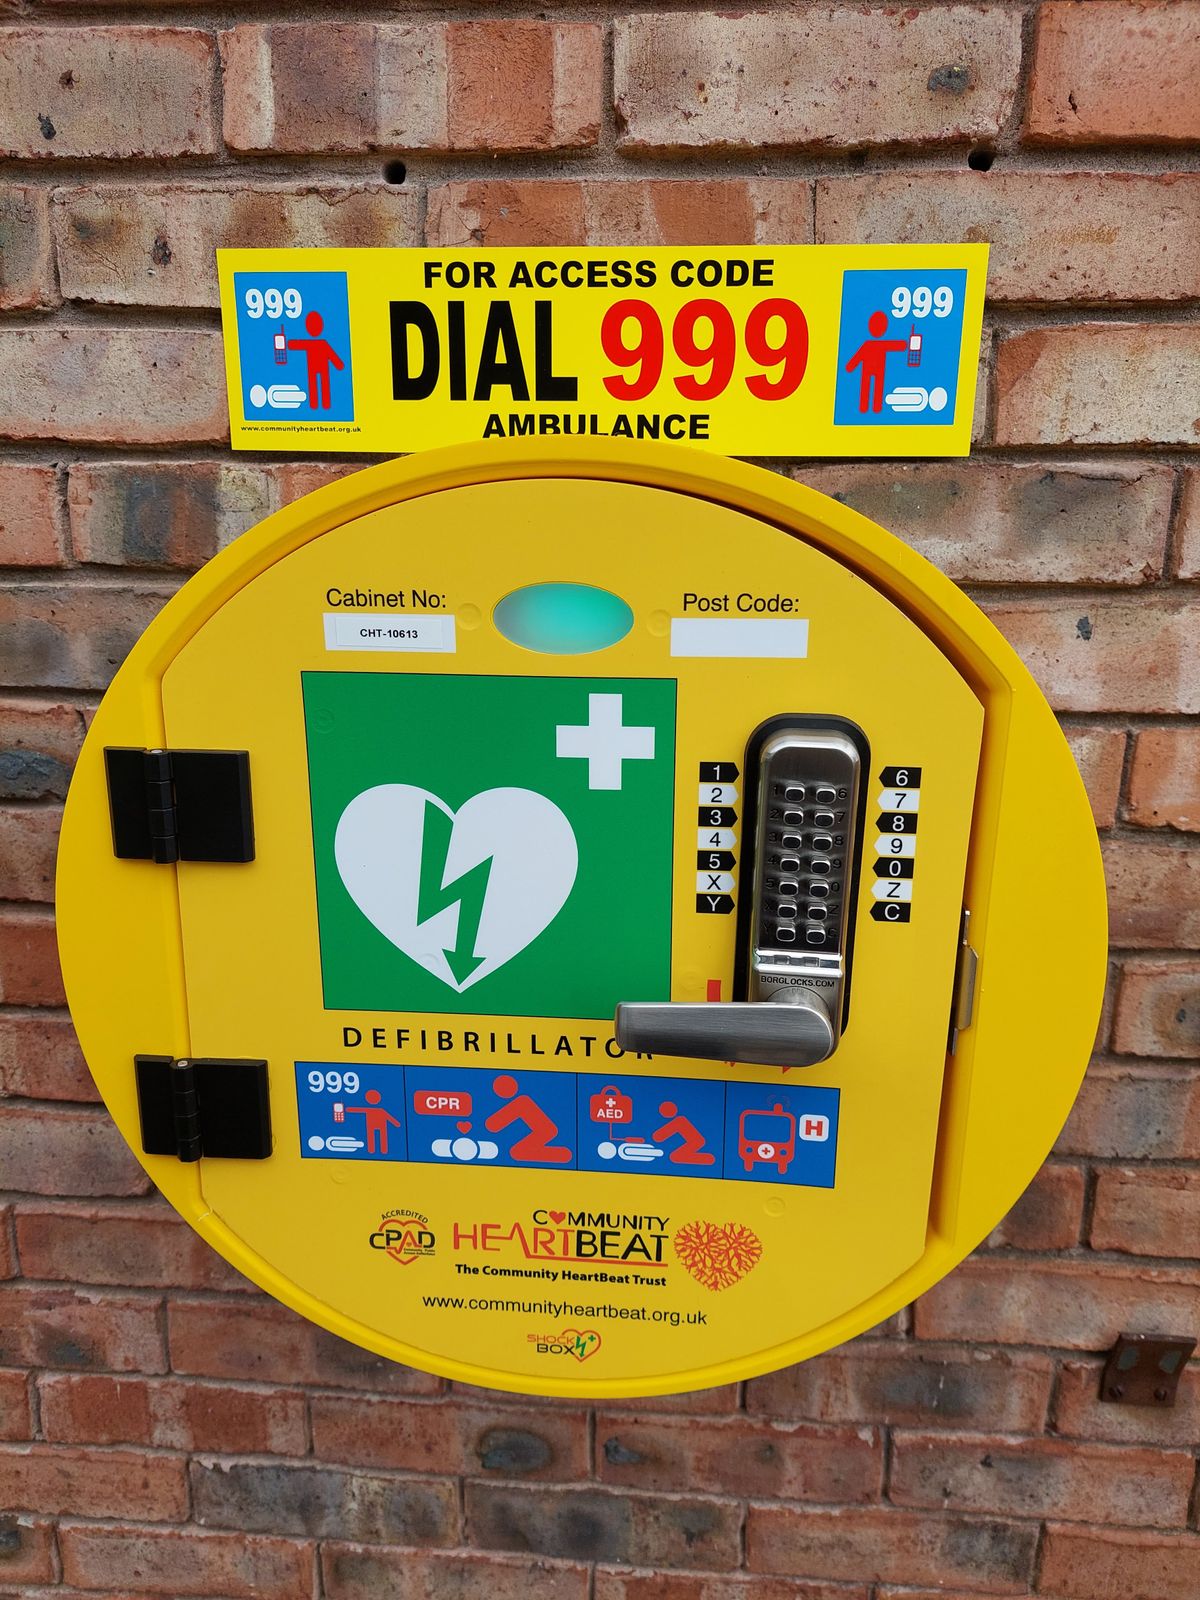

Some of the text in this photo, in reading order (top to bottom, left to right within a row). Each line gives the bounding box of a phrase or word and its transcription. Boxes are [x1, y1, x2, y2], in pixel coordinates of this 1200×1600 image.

[424, 259, 775, 289] FOR ACCESS CODE
[245, 288, 303, 319] 999
[891, 286, 954, 319] 999
[389, 298, 810, 402] DIAL 999
[240, 424, 362, 434] www.communityheartbeat.org.uk
[482, 413, 710, 439] AMBULANCE
[326, 588, 447, 608] Cabinet No:
[683, 592, 800, 613] Post Code:
[359, 628, 419, 639] CHT-10613
[712, 765, 721, 781] 1
[895, 769, 909, 786] 6
[710, 787, 723, 804] 2
[894, 792, 907, 809] 7
[709, 810, 722, 825] 3
[892, 815, 905, 831] 8
[709, 832, 721, 847] 4
[890, 838, 903, 854] 9
[708, 854, 721, 869] 5
[888, 860, 902, 877] 0
[707, 875, 722, 890] X
[886, 882, 901, 898] Z
[706, 896, 721, 912] Y
[884, 903, 901, 921] C
[760, 975, 835, 988] BORGLOCKS.COM
[307, 1070, 360, 1094] 999
[425, 1096, 460, 1111] CPR
[596, 1107, 624, 1120] AED
[381, 1209, 429, 1223] ACCREDITED
[369, 1229, 436, 1254] CPAD
[455, 1264, 667, 1286] The Community HeartBeat Trust
[422, 1295, 708, 1326] www.communityheartbeat.org.uk
[527, 1334, 575, 1345] SHOCK
[536, 1344, 576, 1355] BOX
